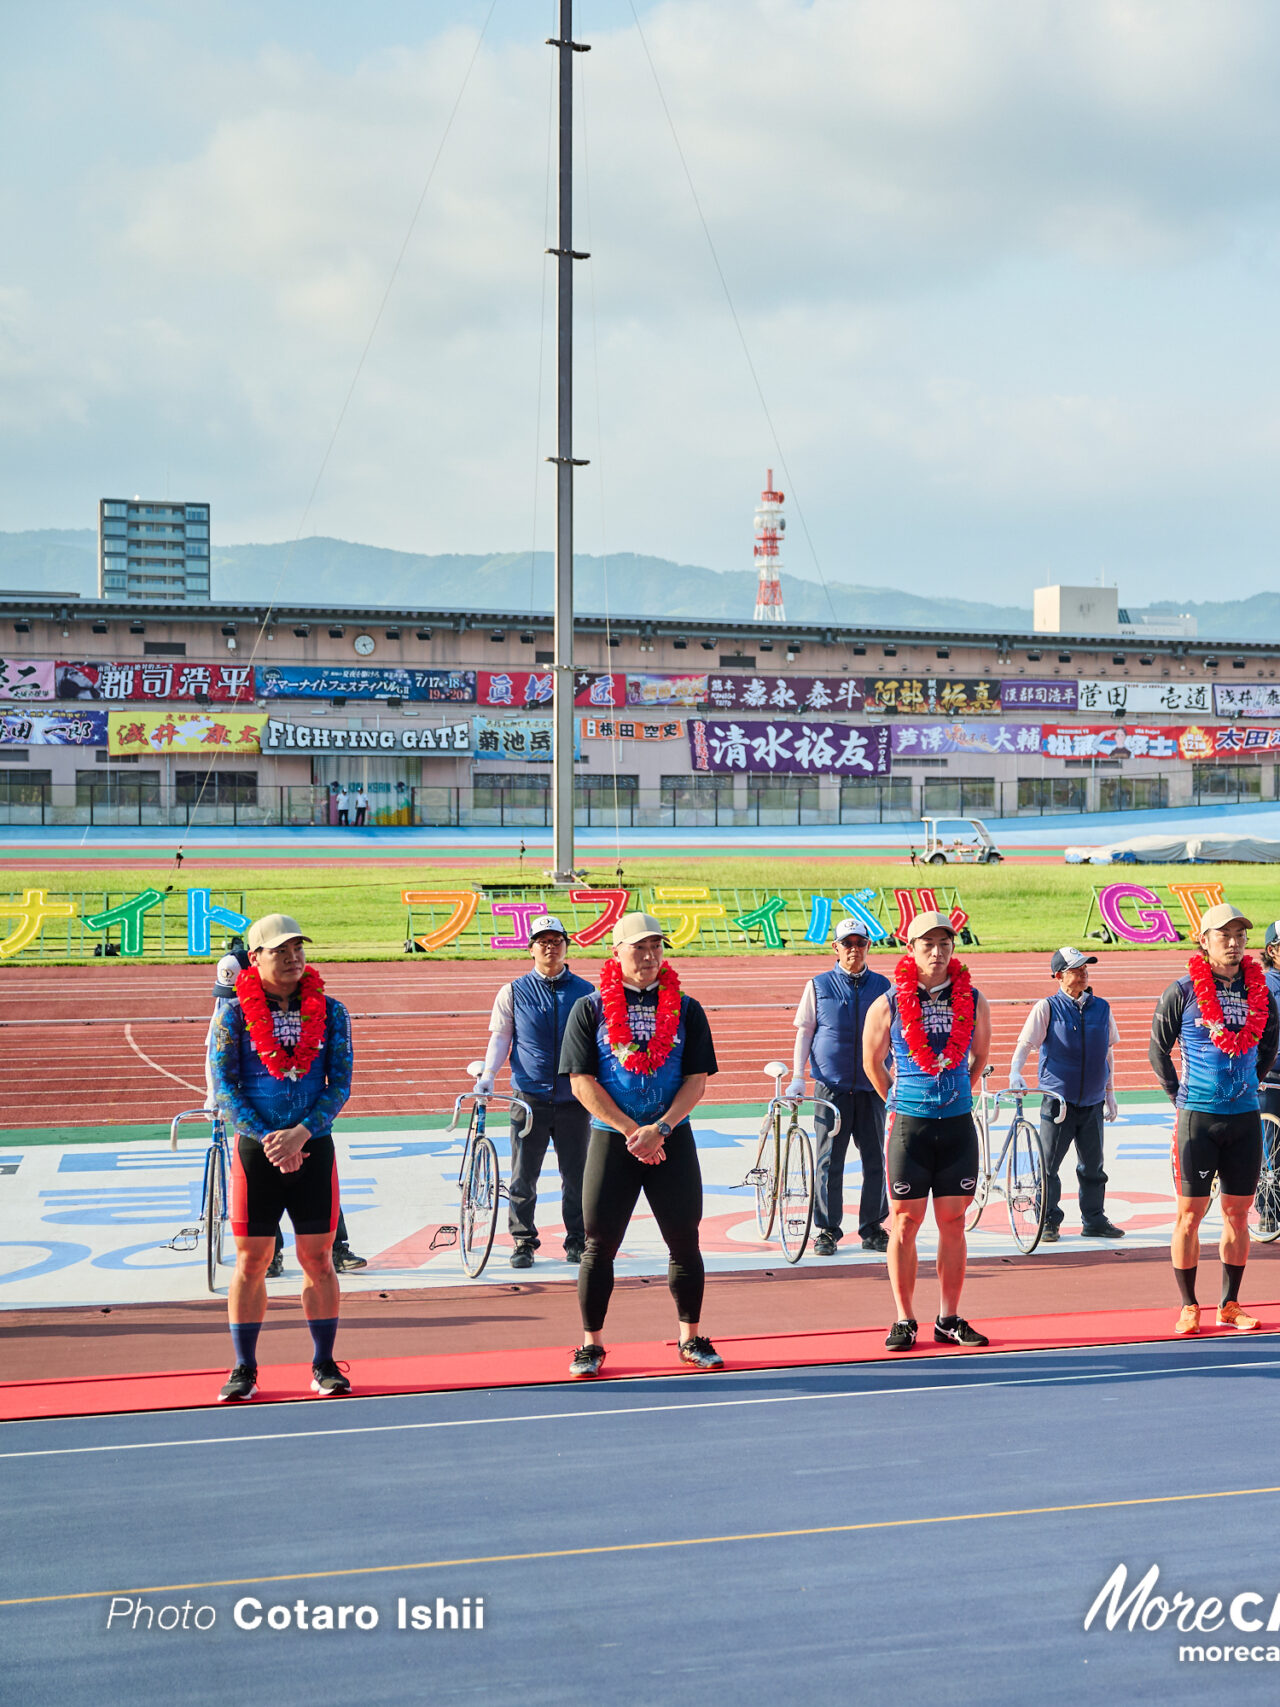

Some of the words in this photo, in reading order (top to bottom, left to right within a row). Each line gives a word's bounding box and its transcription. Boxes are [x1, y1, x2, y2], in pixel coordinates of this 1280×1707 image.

[100, 666, 251, 699] 郡司浩平
[266, 679, 399, 692] サマーナイトフェスティバル
[268, 719, 396, 748] FIGHTING
[402, 721, 470, 749] GATE
[709, 723, 875, 771] 清水裕友
[0, 888, 252, 959] ナイト
